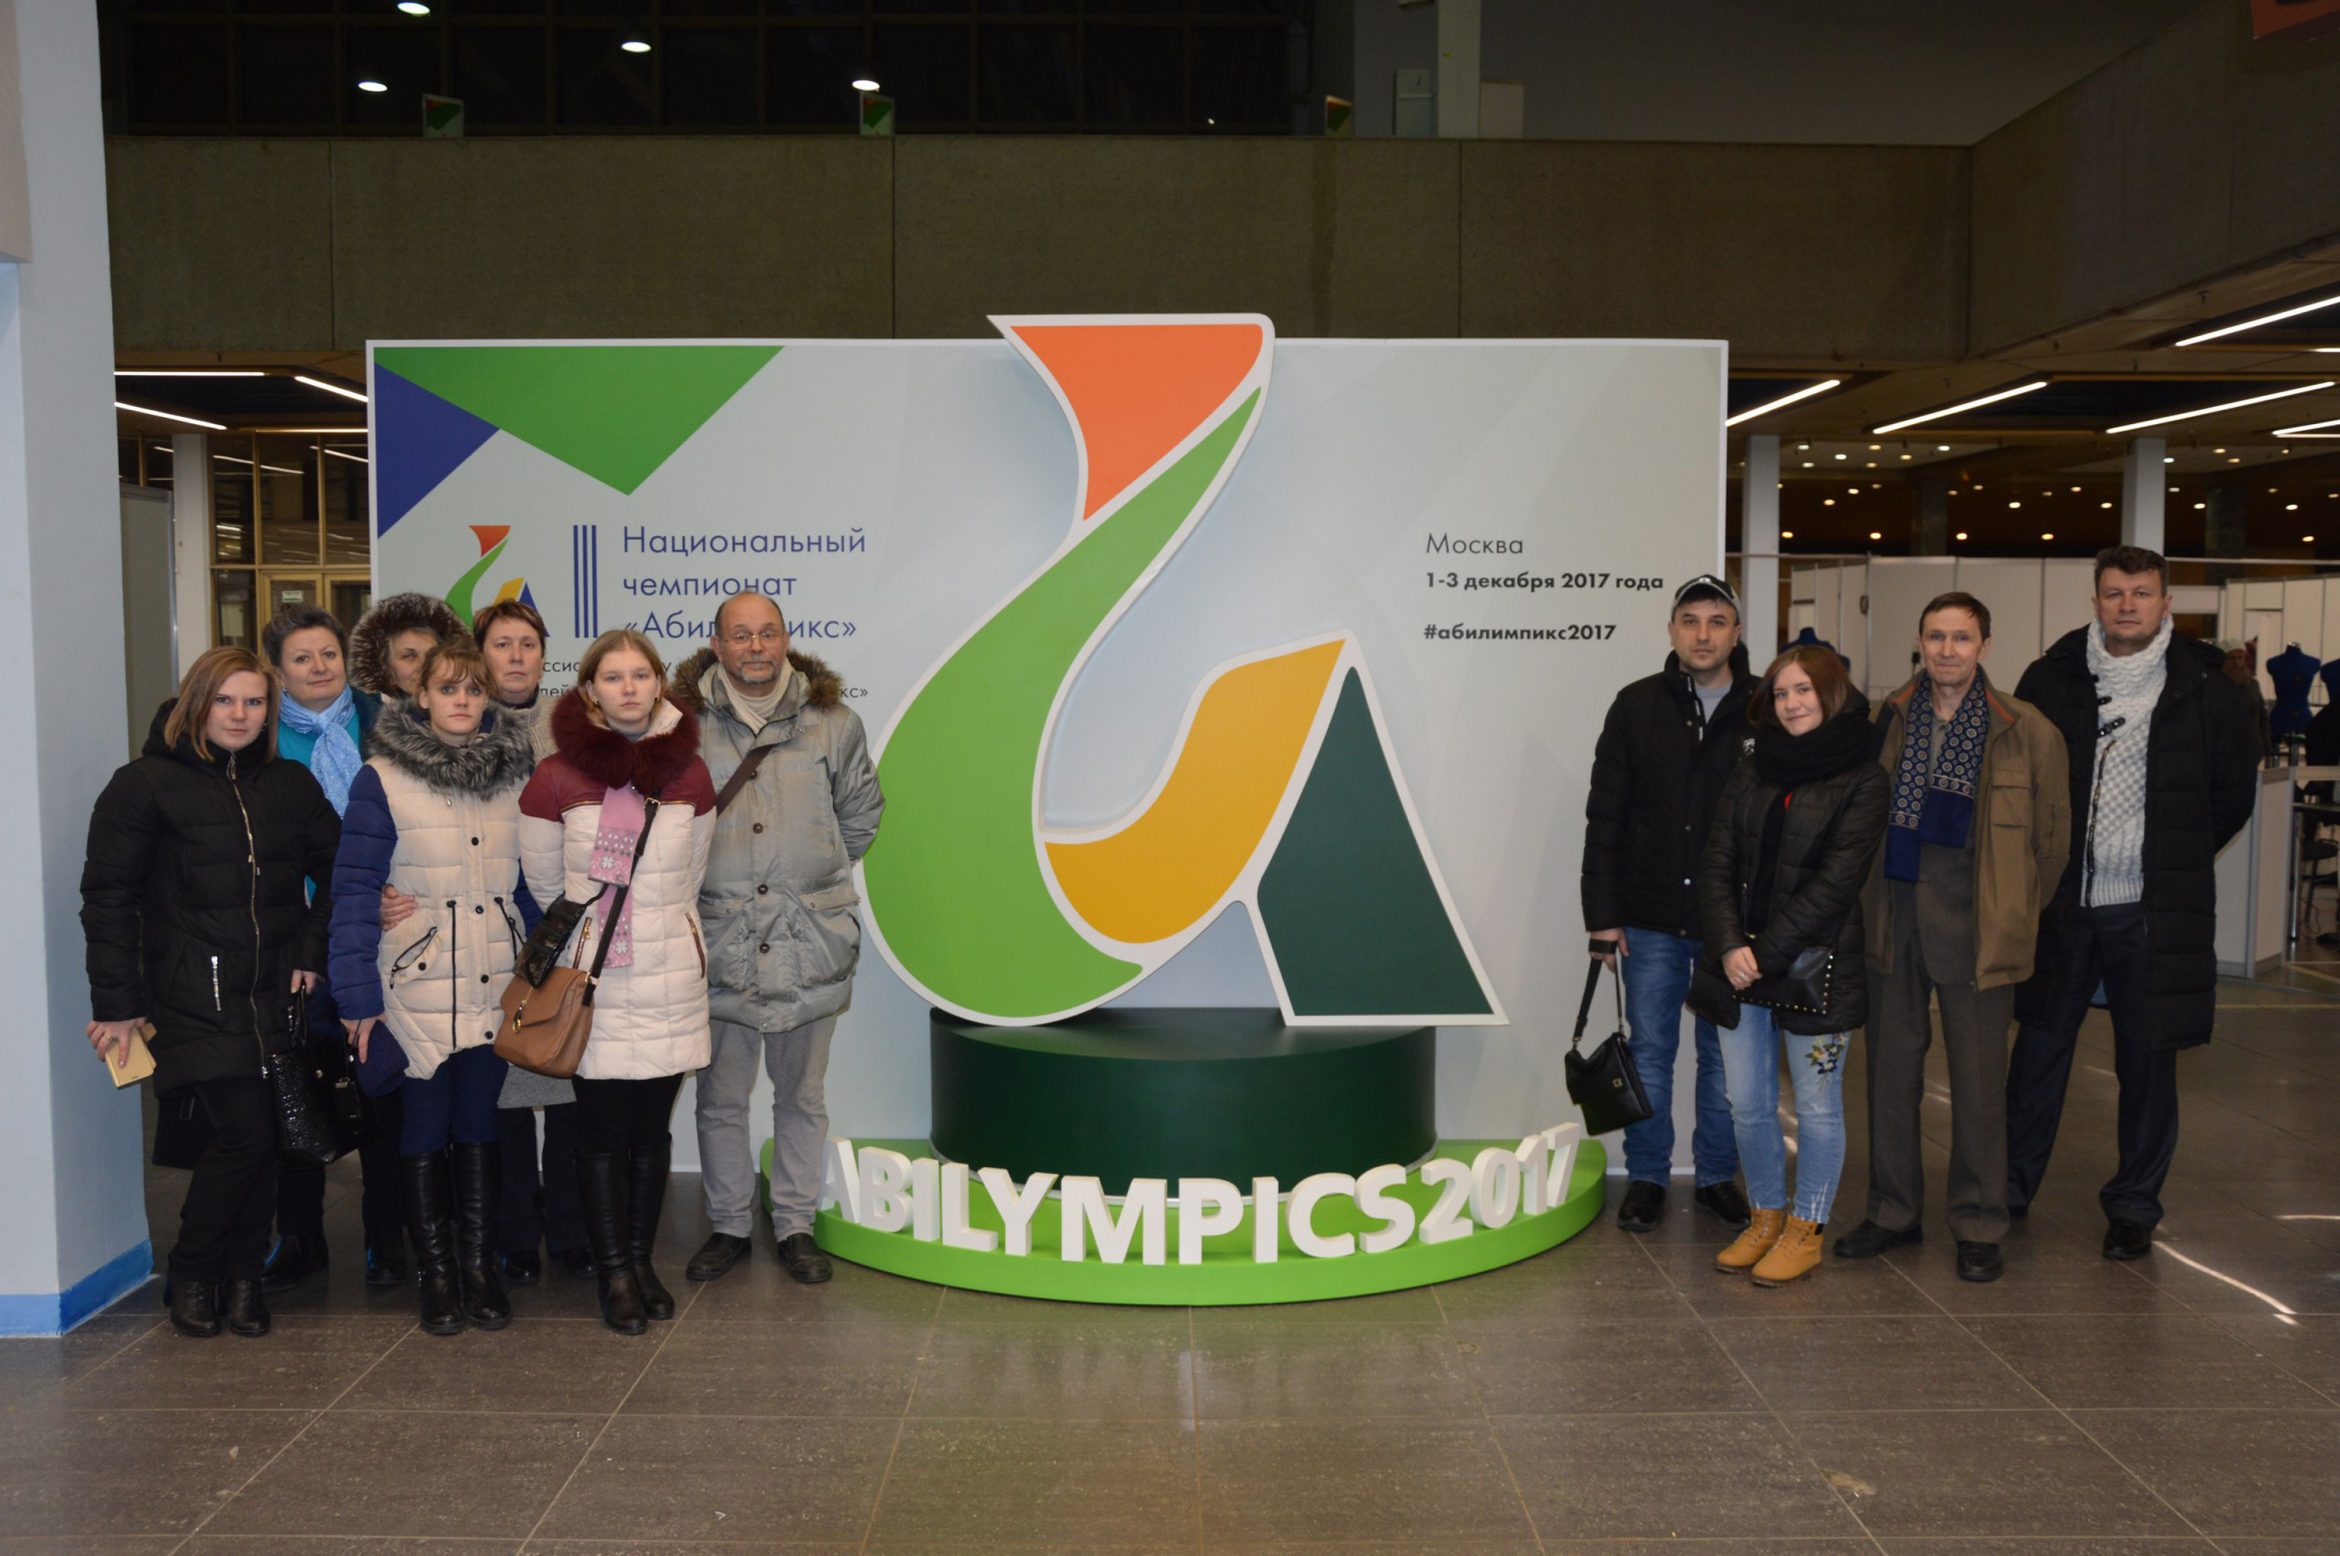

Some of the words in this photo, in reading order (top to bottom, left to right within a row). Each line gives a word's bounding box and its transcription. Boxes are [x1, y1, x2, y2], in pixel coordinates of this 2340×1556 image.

[623, 525, 866, 557] Национальный
[1426, 532, 1524, 554] Москва
[623, 577, 797, 596] чемпионат
[1427, 571, 1458, 588] 1-3
[1464, 571, 1555, 592] декабря
[1561, 572, 1610, 588] 2017
[1616, 577, 1664, 591] года
[1424, 623, 1617, 640] #абилимпикс2017
